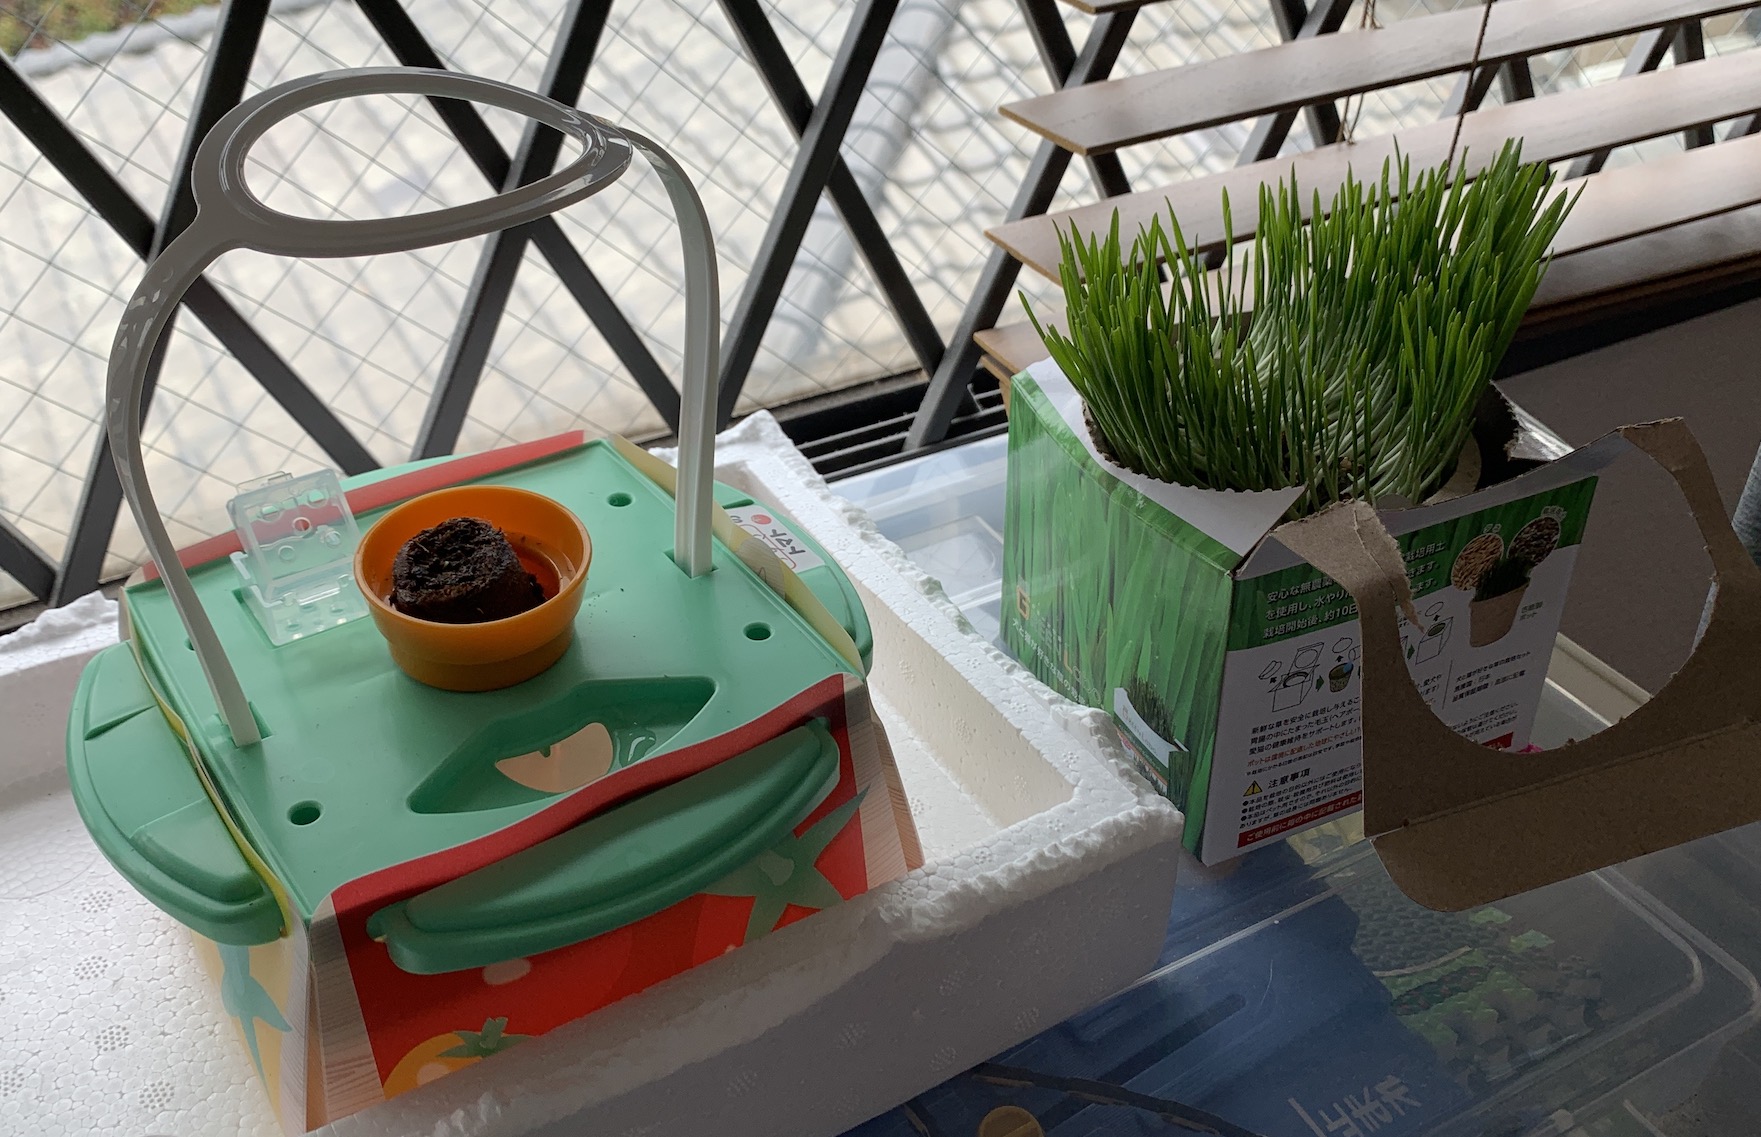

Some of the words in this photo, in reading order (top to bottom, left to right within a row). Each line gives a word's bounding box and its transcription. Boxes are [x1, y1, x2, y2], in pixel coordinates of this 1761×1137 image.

[770, 529, 806, 555] トマト
[1265, 590, 1351, 622] を使用し、水やり
[1268, 767, 1311, 790] 注意事項
